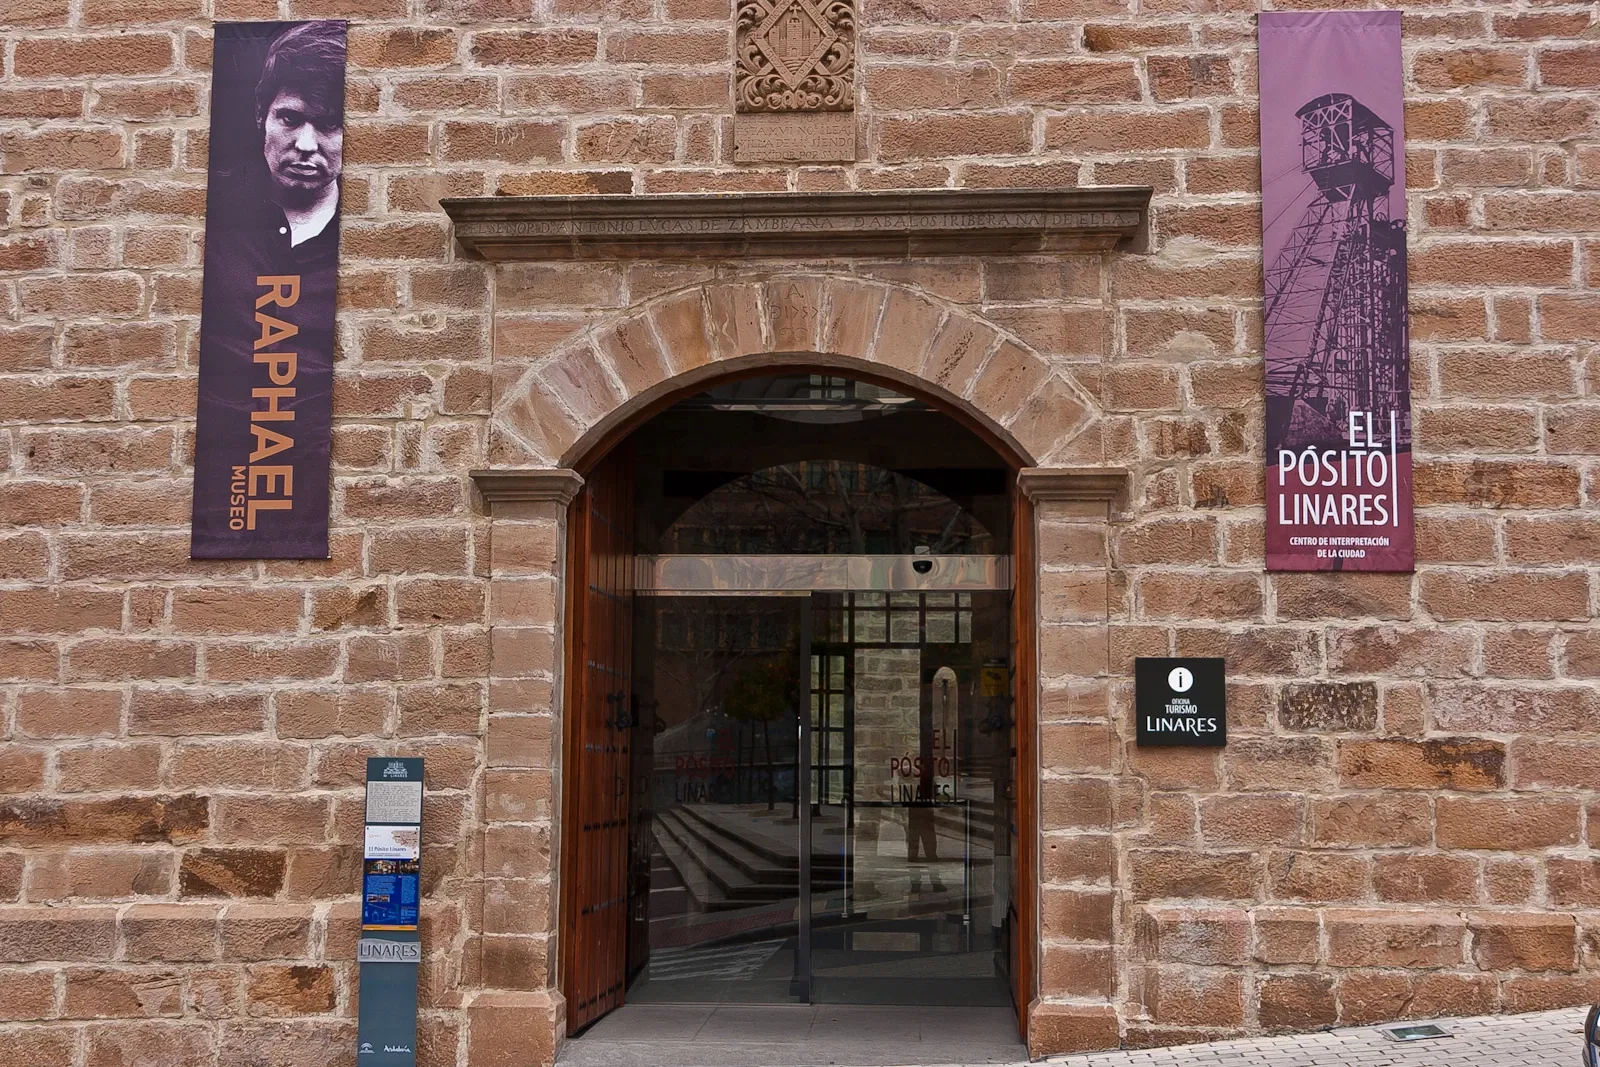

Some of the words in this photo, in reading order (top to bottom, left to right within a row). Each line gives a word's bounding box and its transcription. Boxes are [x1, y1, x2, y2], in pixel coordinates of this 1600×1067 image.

[700, 218, 721, 231] DE
[246, 274, 301, 530] RAPHAEL
[1350, 411, 1382, 448] EL
[1278, 445, 1388, 487] PÓSITO
[229, 465, 246, 531] MUSEO
[1279, 493, 1389, 526] LINARES
[1289, 537, 1317, 546] CENTRO
[1318, 537, 1328, 546] DE
[1329, 536, 1389, 546] INTERPRETACIÓN
[1317, 549, 1327, 558] DE
[1328, 549, 1337, 558] LA
[1338, 549, 1365, 558] CIUDAD
[1165, 704, 1197, 714] TURISMO
[1146, 716, 1217, 736] LINARES
[933, 729, 951, 749] EL
[890, 751, 950, 778] PÓSTO
[360, 943, 418, 960] LINARES
